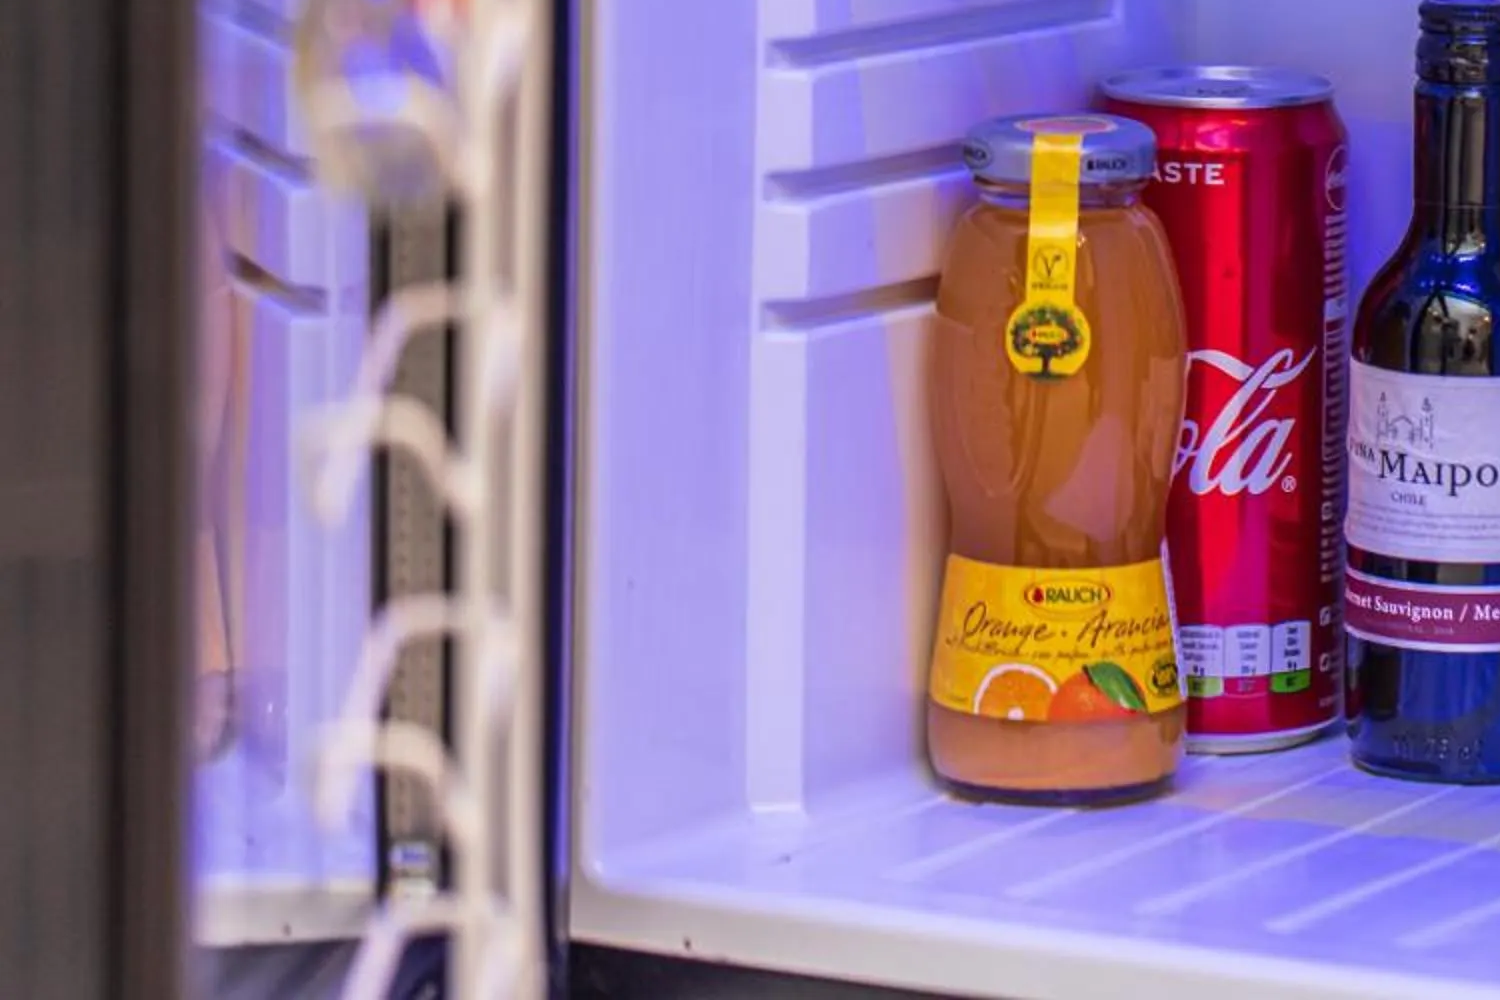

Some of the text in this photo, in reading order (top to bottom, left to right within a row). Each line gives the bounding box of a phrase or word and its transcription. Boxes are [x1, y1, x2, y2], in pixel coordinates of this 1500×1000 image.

[1151, 161, 1225, 186] ASTE
[1172, 346, 1317, 495] ola
[1391, 491, 1427, 506] CHILE
[1045, 588, 1101, 604] RAUCH
[1375, 595, 1453, 623] Sauvignon
[963, 601, 1052, 651] Orange
